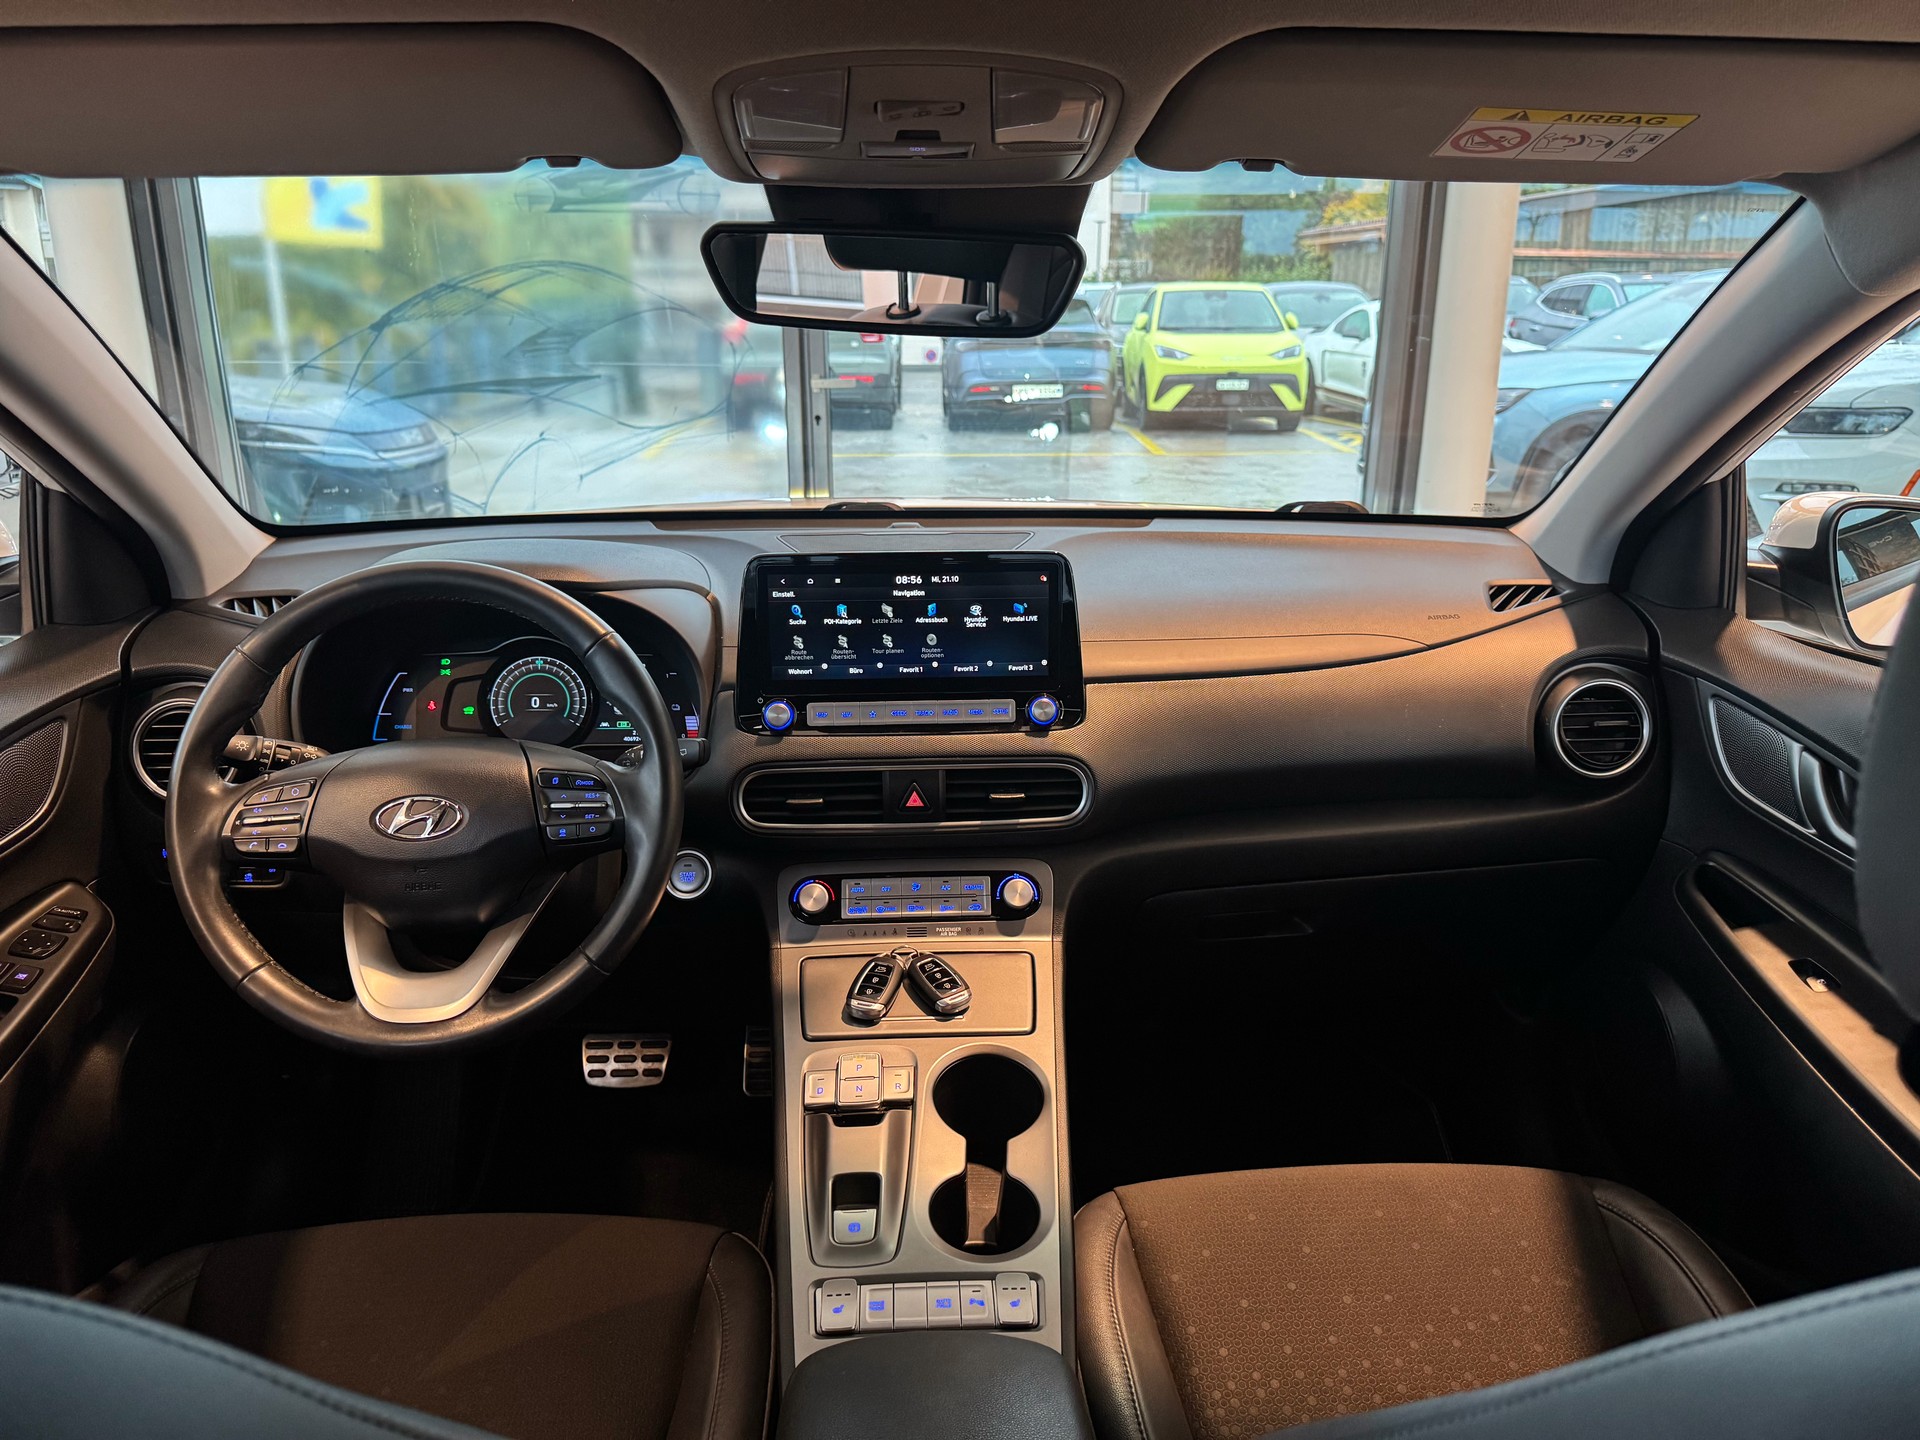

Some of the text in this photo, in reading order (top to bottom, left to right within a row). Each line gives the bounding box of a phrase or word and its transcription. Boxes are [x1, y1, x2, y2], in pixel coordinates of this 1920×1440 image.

[1554, 114, 1667, 125] AIRBAG
[896, 575, 922, 584] 08:56
[893, 590, 925, 598] Navigation
[824, 618, 861, 626] POI-Kategorie
[964, 616, 988, 624] Hyundai-
[531, 697, 540, 708] 0
